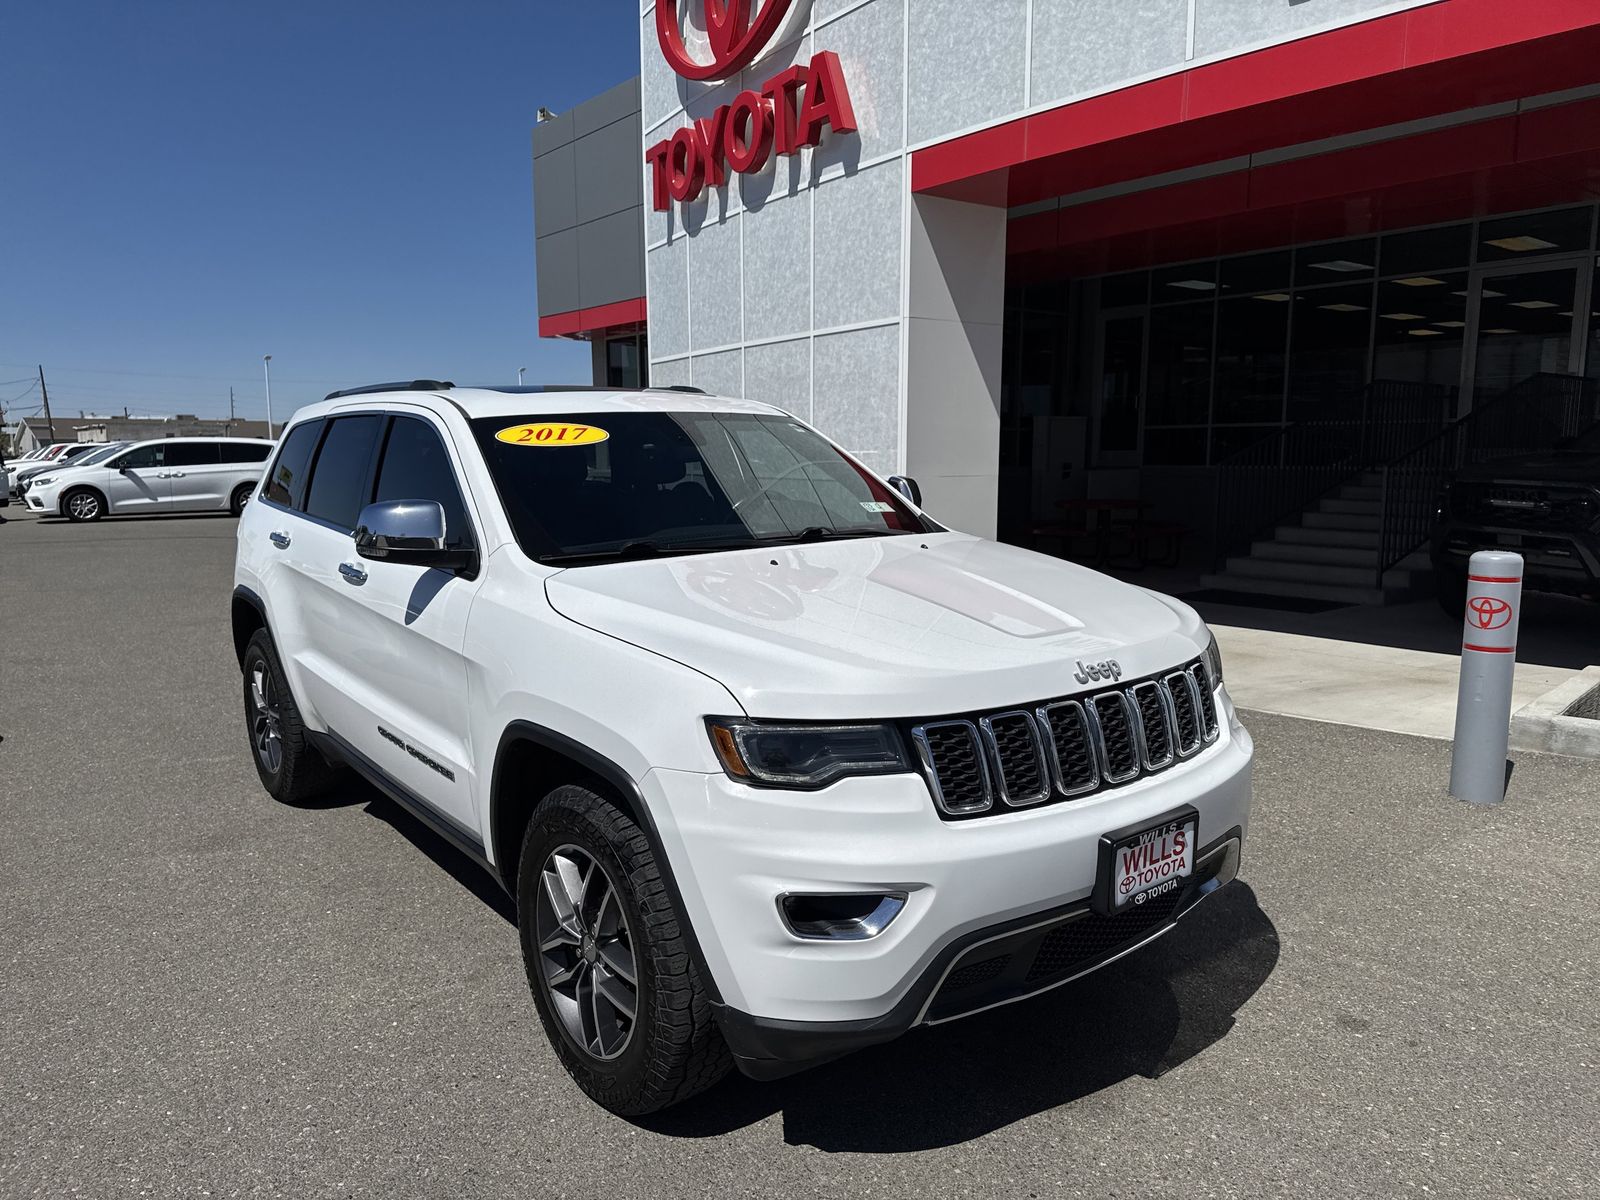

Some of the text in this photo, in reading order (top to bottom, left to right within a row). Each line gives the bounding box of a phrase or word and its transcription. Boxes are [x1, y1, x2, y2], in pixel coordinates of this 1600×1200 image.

[646, 50, 857, 212] TOYOTA
[516, 427, 588, 442] 2017
[1073, 660, 1122, 685] Jeep
[1139, 823, 1177, 845] WILLS
[1123, 831, 1185, 876] WILLS
[1137, 856, 1186, 887] TOYOTA
[1148, 880, 1178, 899] TOYOTA
